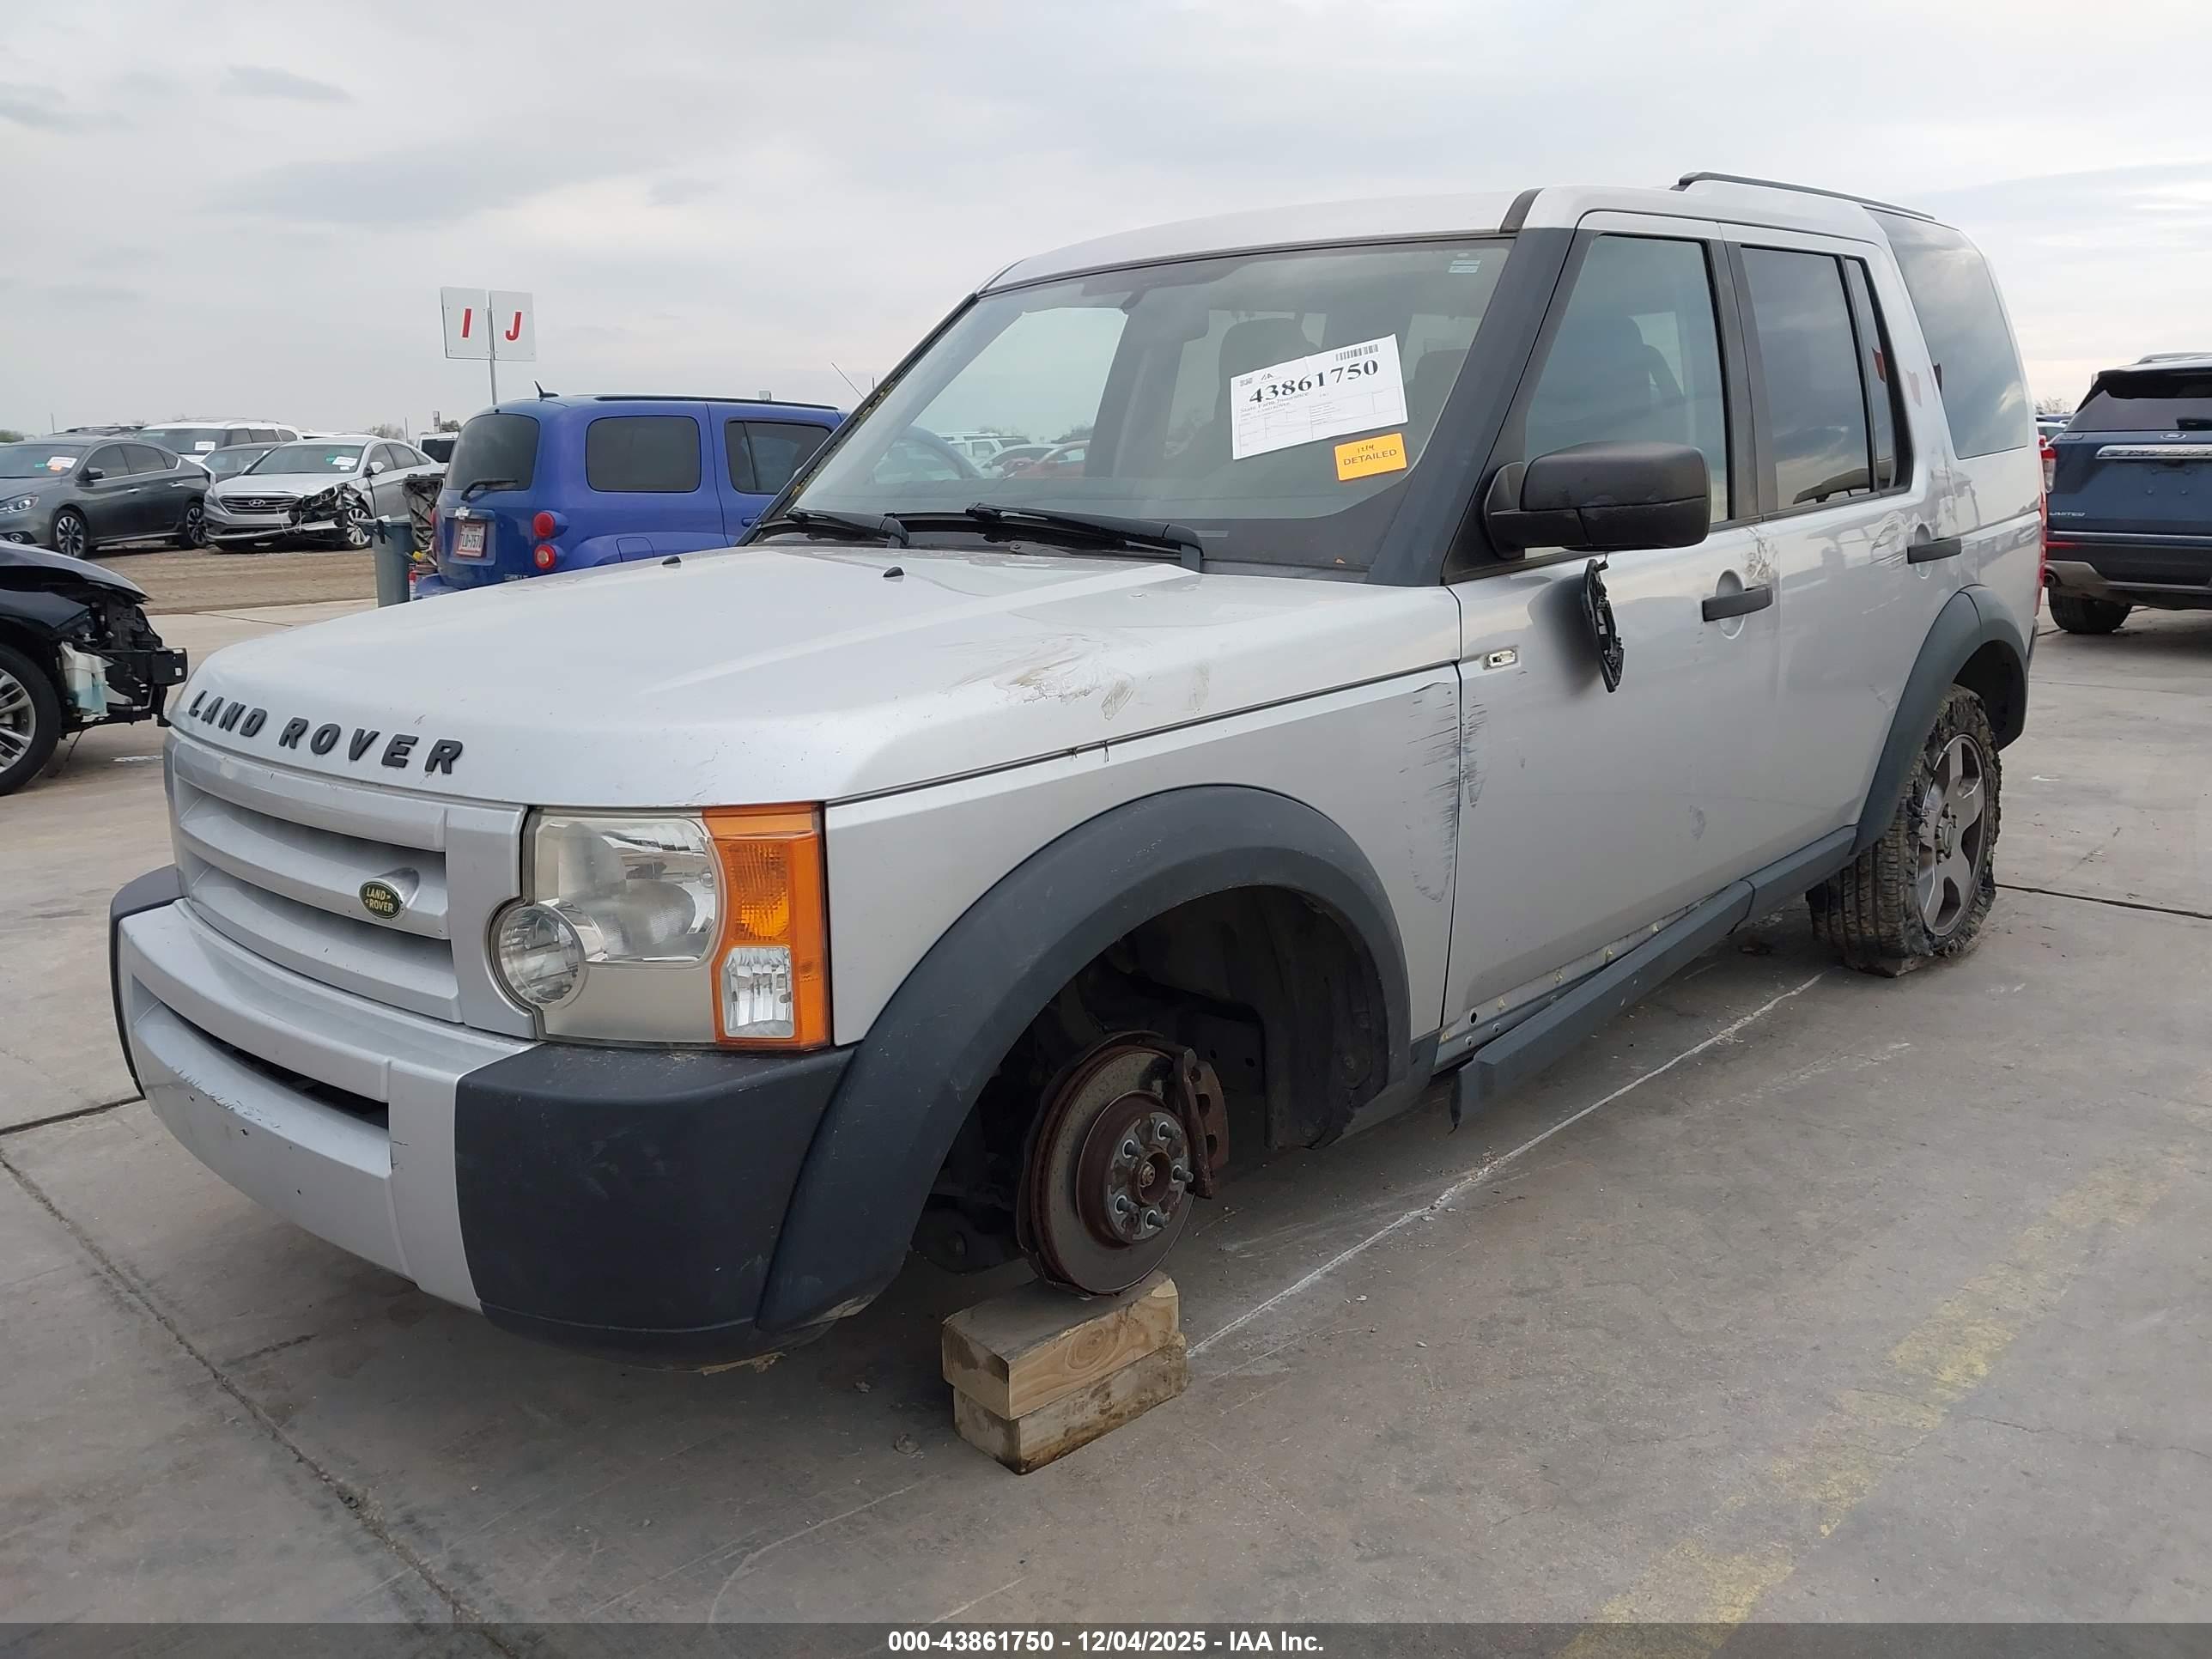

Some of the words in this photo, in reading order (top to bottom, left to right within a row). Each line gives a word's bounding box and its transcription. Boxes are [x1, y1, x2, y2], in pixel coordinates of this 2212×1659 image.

[461, 307, 472, 338] I
[504, 311, 523, 341] J
[1249, 359, 1379, 404] 43861750
[1343, 448, 1397, 465] DETAILED
[187, 690, 268, 738] LAND
[278, 717, 464, 775] ROVER
[366, 887, 386, 900] LAND
[369, 899, 394, 913] ROVER
